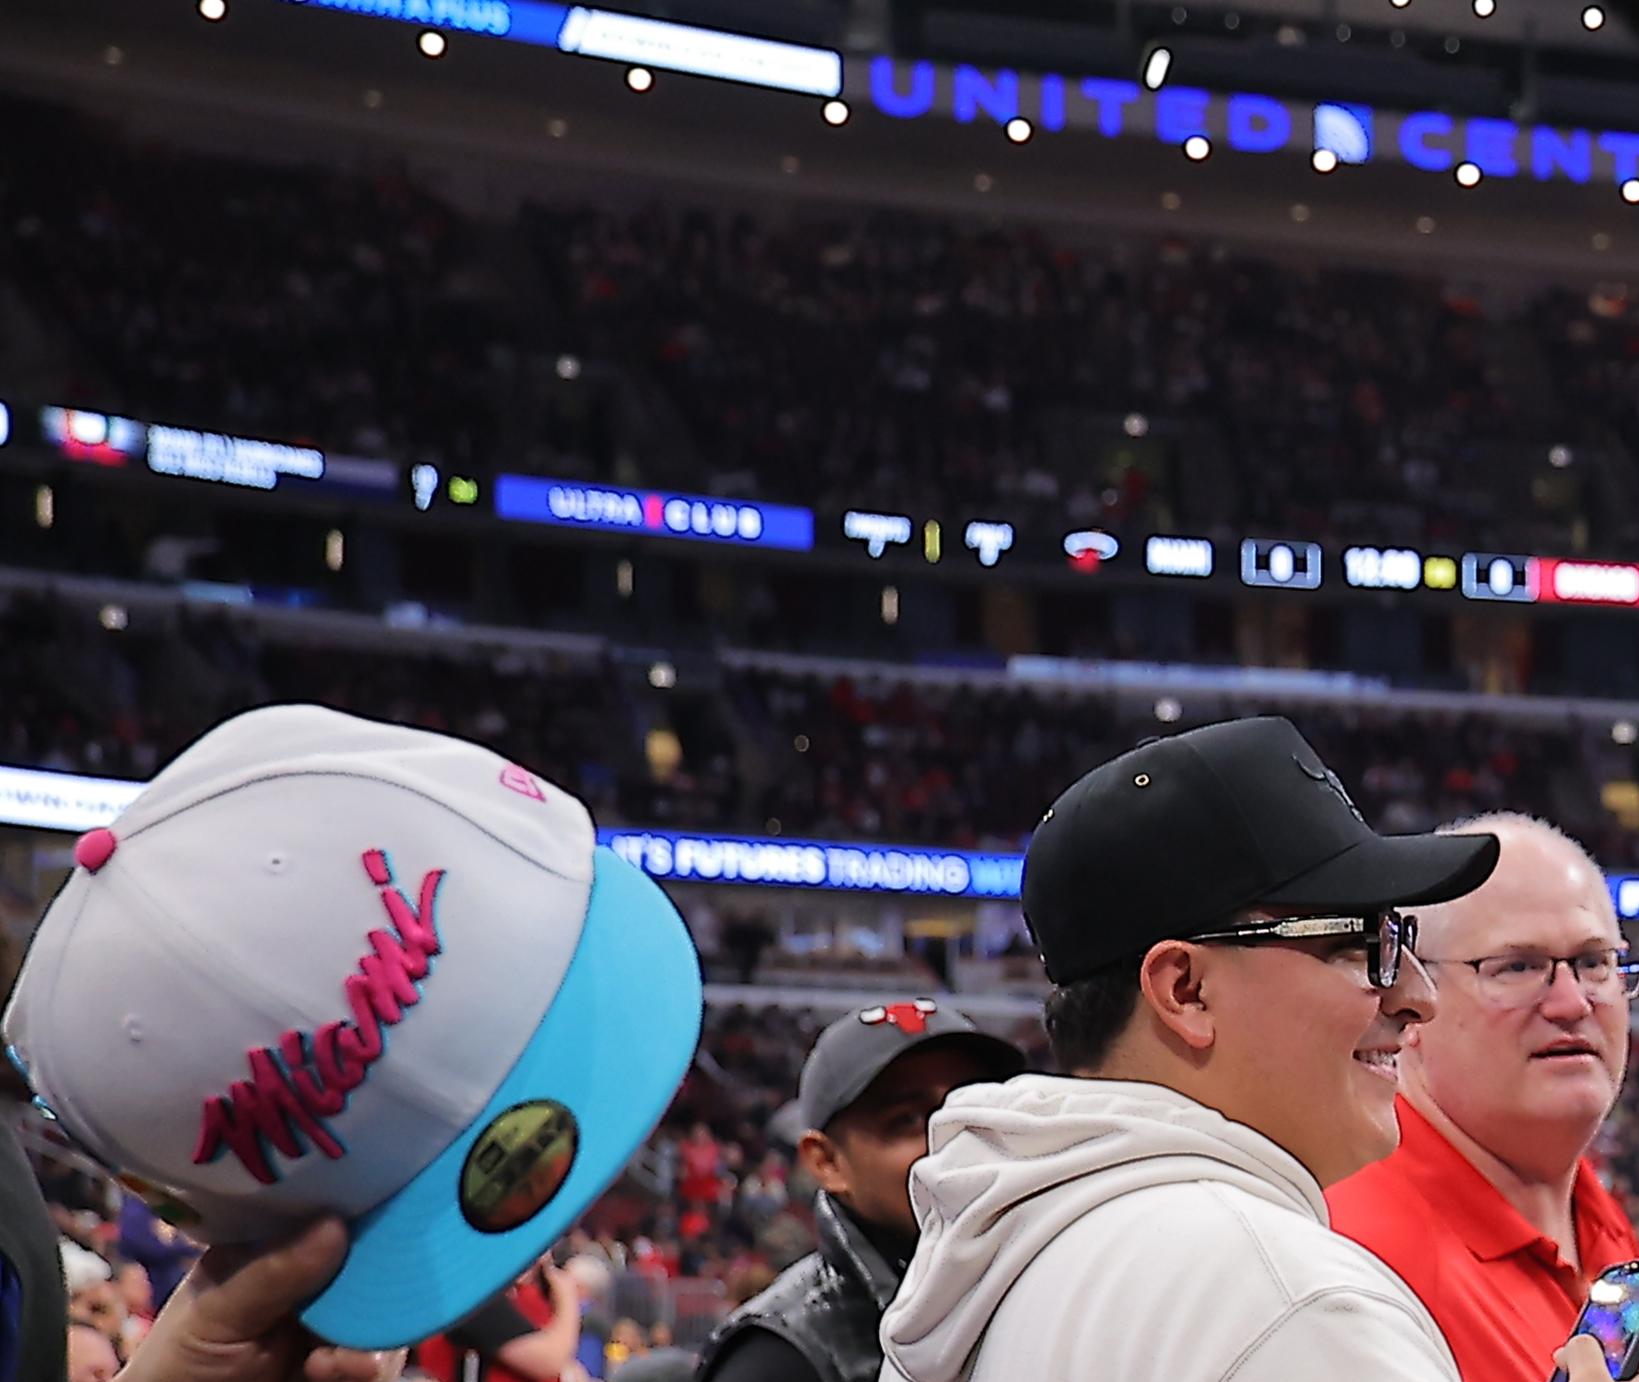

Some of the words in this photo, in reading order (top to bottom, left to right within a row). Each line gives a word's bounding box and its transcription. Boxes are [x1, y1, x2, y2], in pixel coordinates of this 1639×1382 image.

[869, 56, 1291, 154] UNITED
[674, 836, 827, 885] FUTURES
[827, 846, 970, 894] TRADING
[193, 848, 446, 1184] Miami
